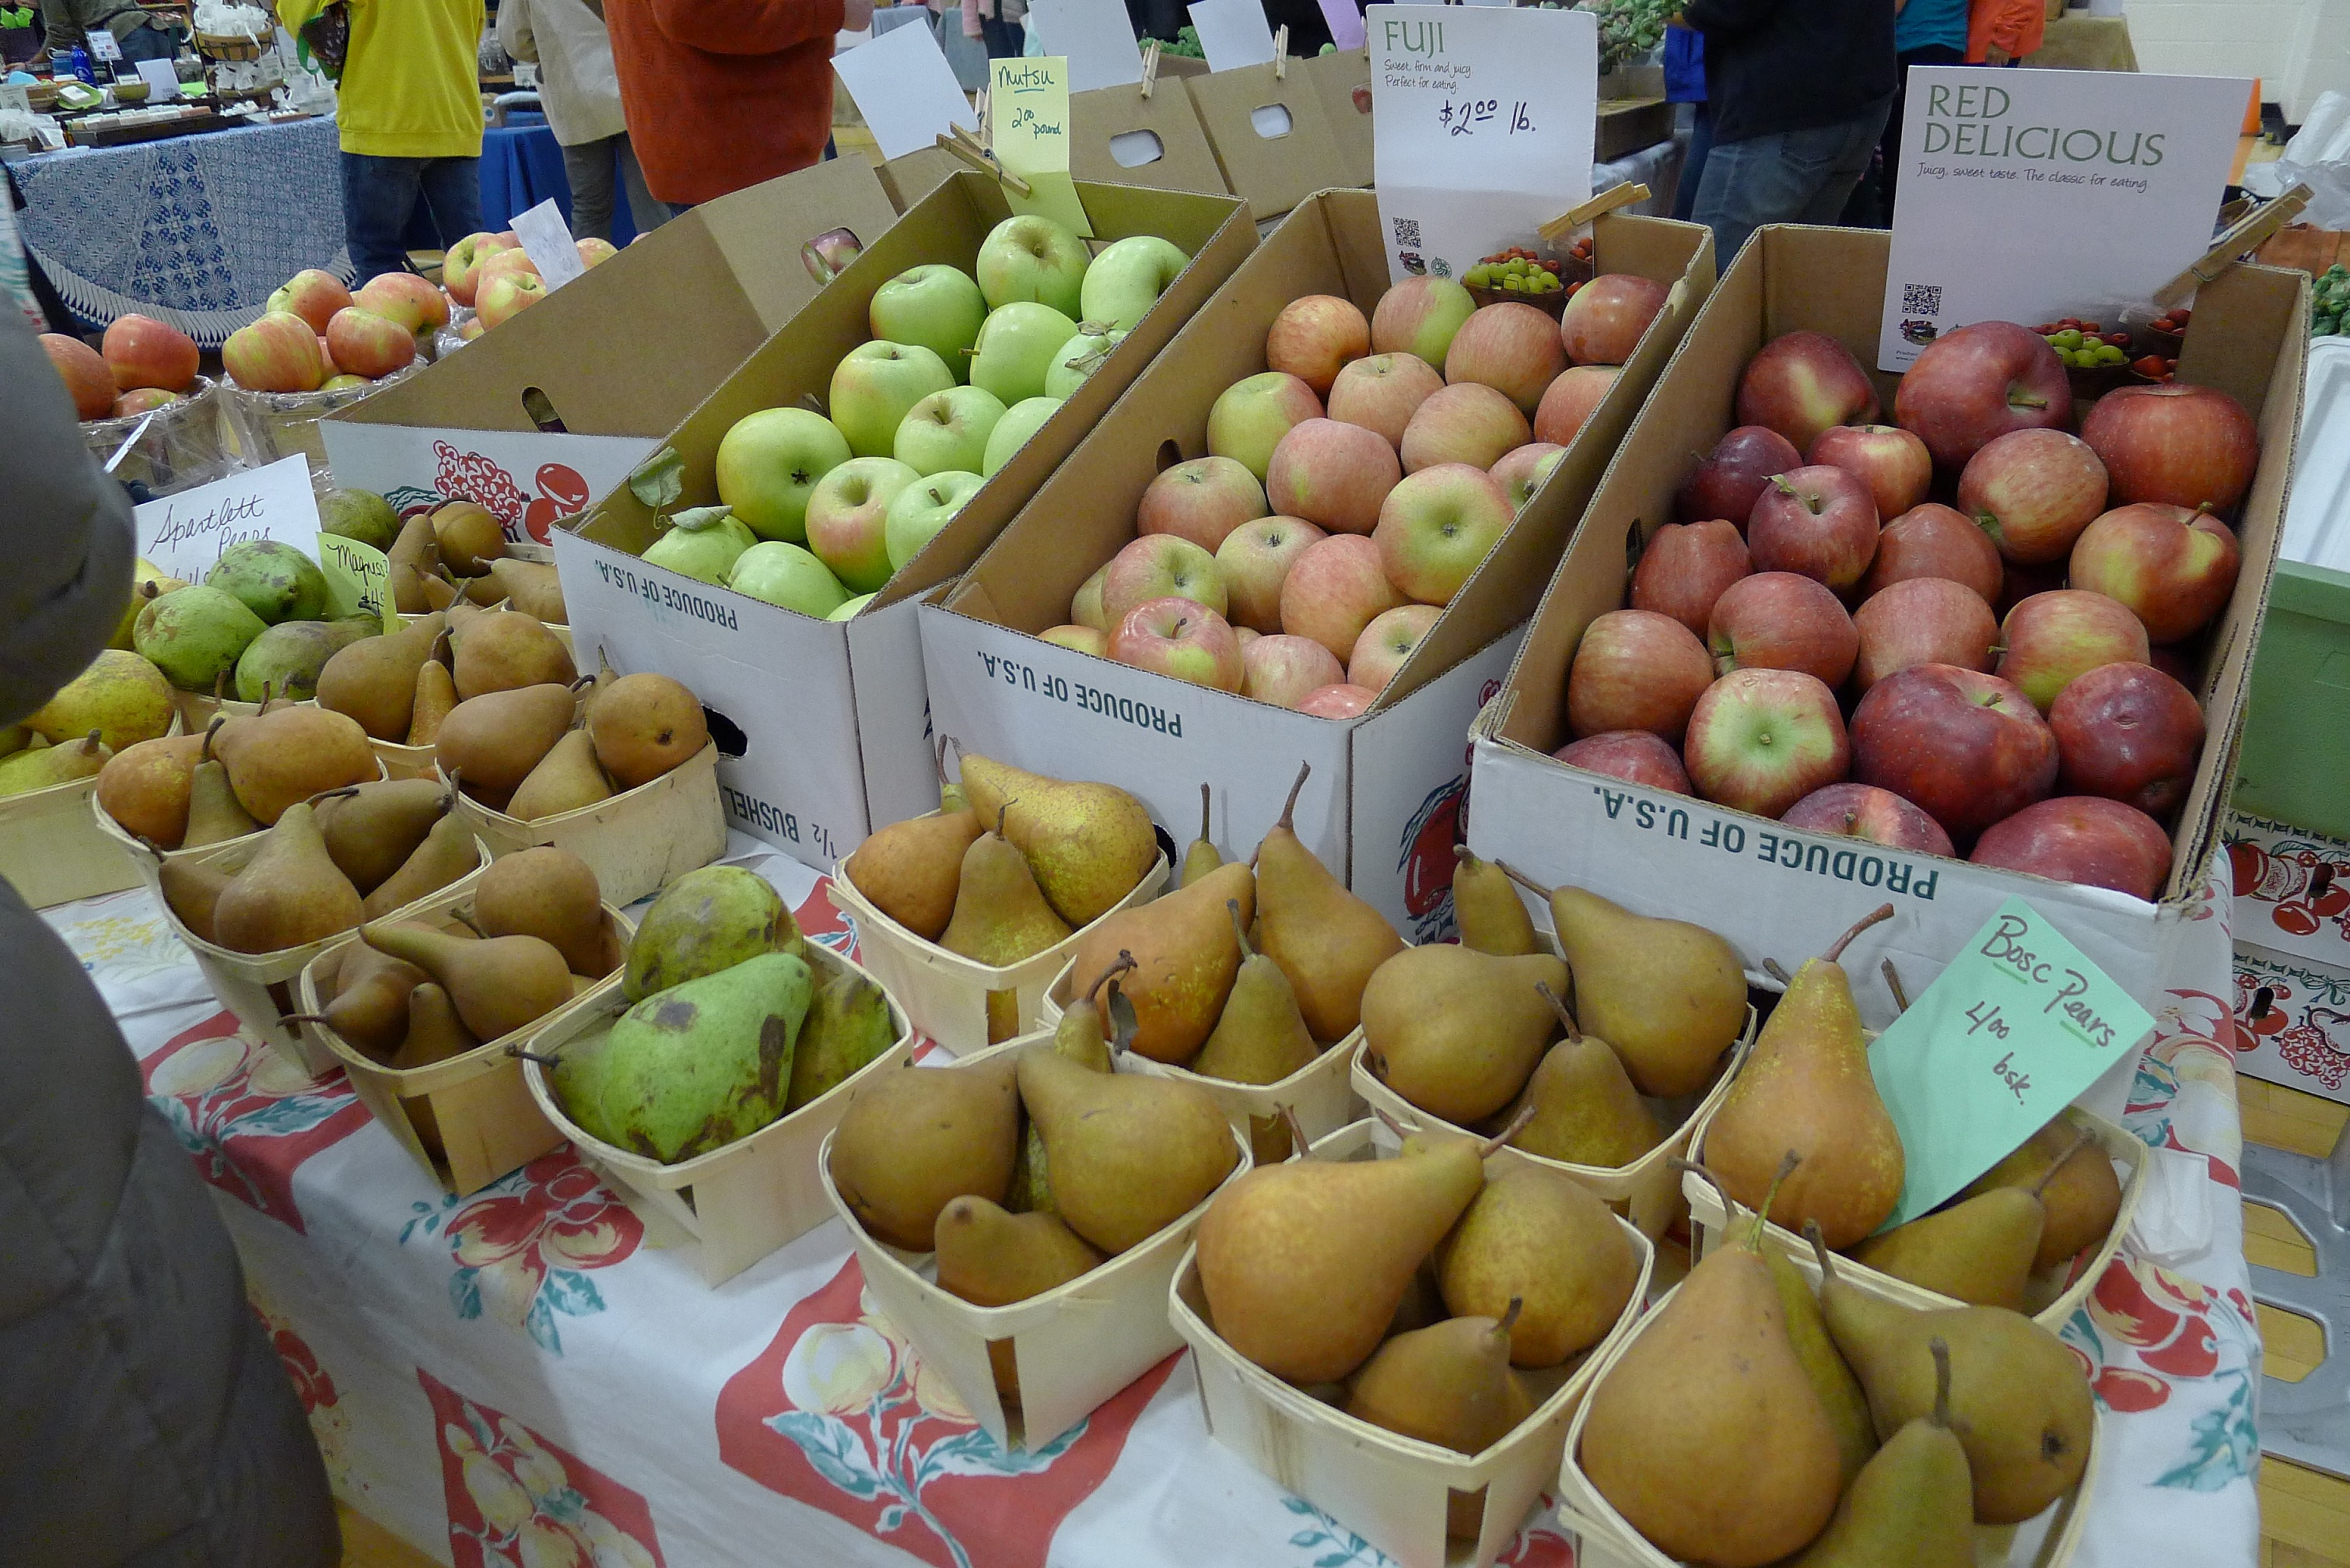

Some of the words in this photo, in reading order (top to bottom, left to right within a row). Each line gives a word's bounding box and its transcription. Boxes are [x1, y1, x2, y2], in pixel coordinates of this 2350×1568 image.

[1384, 20, 1445, 59] FUJI
[998, 65, 1055, 89] Mutsu
[1385, 74, 1416, 88] Perfect
[1418, 76, 1430, 89] for
[1432, 79, 1459, 95] eating.
[1414, 60, 1432, 72] firm
[1434, 61, 1450, 74] and
[1509, 101, 1536, 135] lb.
[1926, 84, 2011, 119] RED
[1031, 121, 1062, 140] pound
[1922, 121, 2166, 166] DELICIOUS
[1952, 166, 1984, 179] sweet
[1988, 167, 2019, 180] taste.
[2023, 168, 2045, 182] The
[2047, 173, 2086, 185] classic
[2089, 174, 2107, 187] for
[2110, 177, 2150, 194] eating.
[148, 494, 265, 555] Spartlett
[594, 558, 638, 596] U.S.A.
[642, 578, 660, 603] OF
[662, 584, 739, 632] PRODUCE
[976, 650, 1037, 692] U.S.A.
[1042, 674, 1069, 702] OF
[1074, 682, 1183, 739] PRODUCE
[723, 785, 800, 844] BUSHEL
[1592, 786, 1690, 841] U.S.A.
[811, 823, 838, 860] 1/2
[1700, 819, 1746, 854] OF
[1756, 831, 1940, 901] PRODUCE
[1980, 914, 2052, 984] Bosc
[2043, 968, 2117, 1048] Pears
[1991, 1051, 2032, 1106] bsk.
